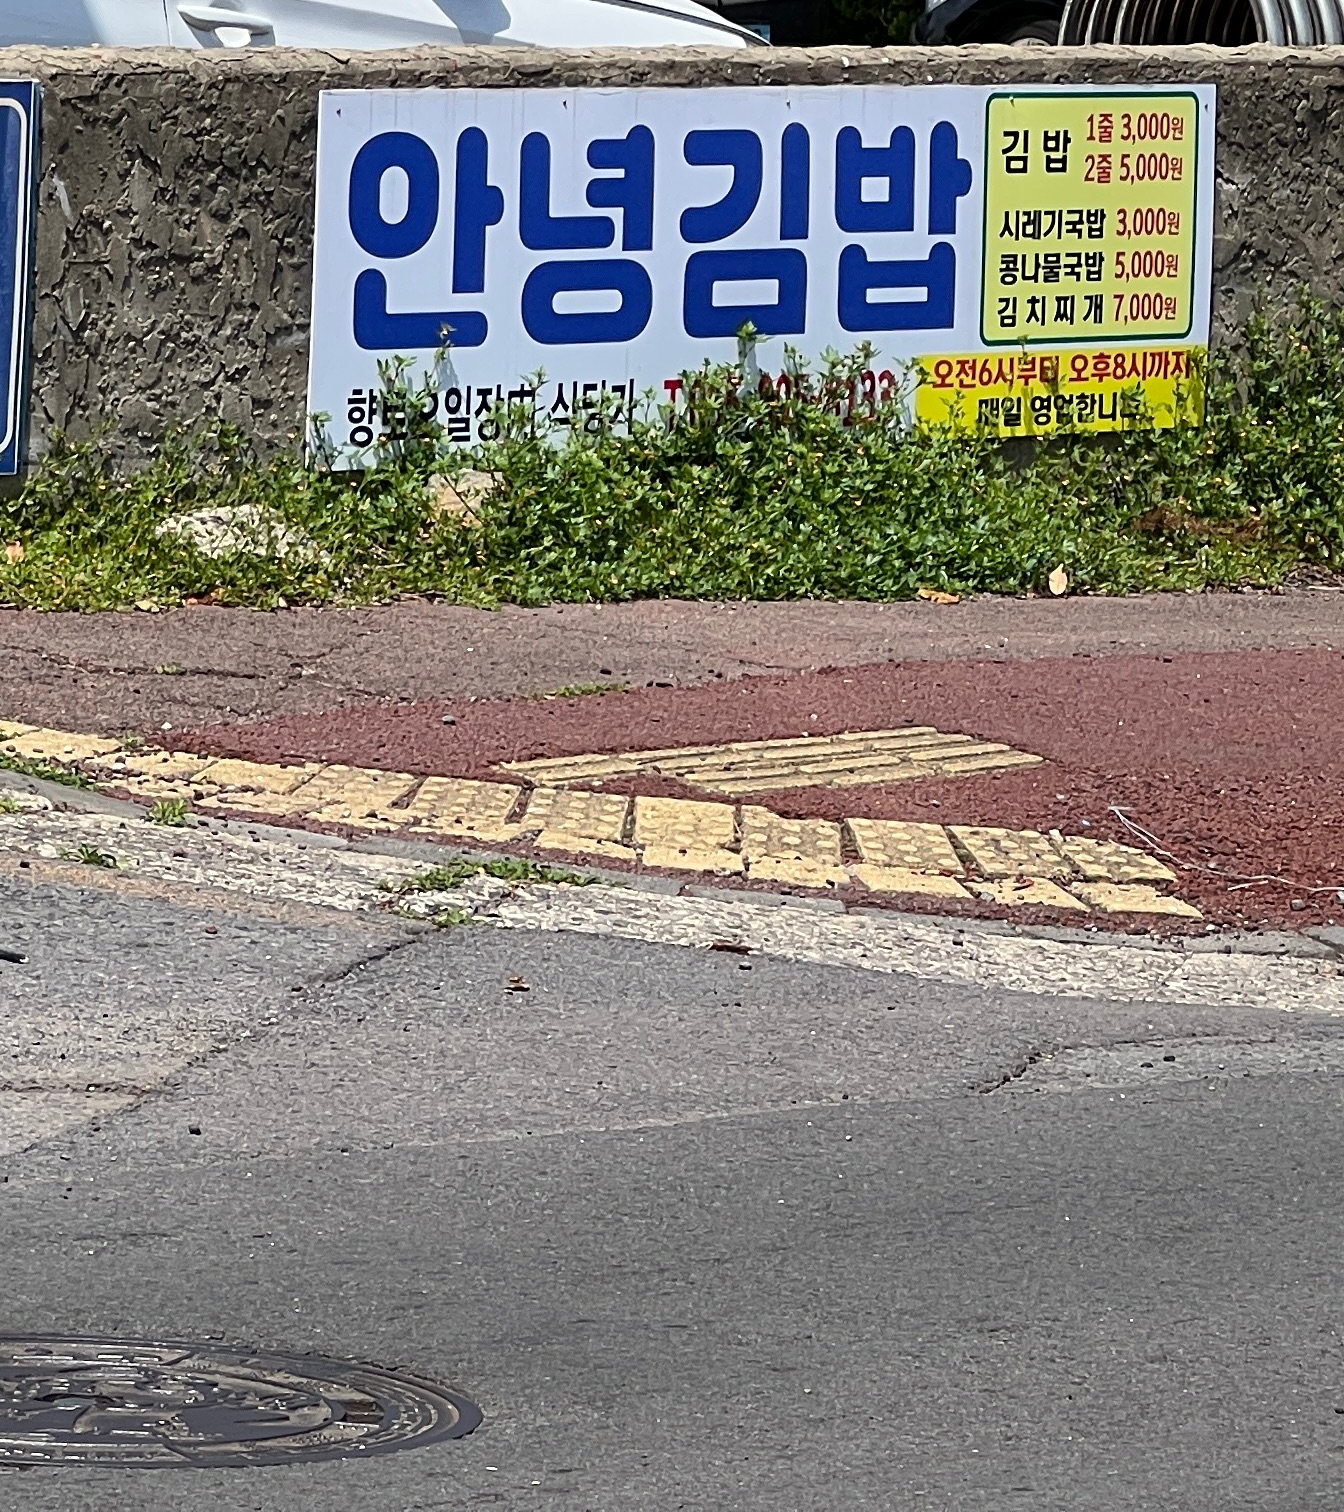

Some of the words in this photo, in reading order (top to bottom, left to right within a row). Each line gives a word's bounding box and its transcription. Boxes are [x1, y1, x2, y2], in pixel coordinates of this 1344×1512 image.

[1086, 113, 1114, 143] 1줄
[1120, 112, 1184, 145] 3,000원
[1084, 153, 1112, 183] 2줄
[1119, 152, 1183, 185] 5,000원
[348, 120, 972, 350] 안녕김밥
[999, 209, 1106, 241] 시레기국밥
[1116, 207, 1180, 240] 3,000원
[999, 252, 1105, 285] 콩나물국밥
[1114, 250, 1179, 283] 5,000원
[1113, 292, 1177, 325] 7,000원
[1068, 351, 1192, 383] 오후8시까지
